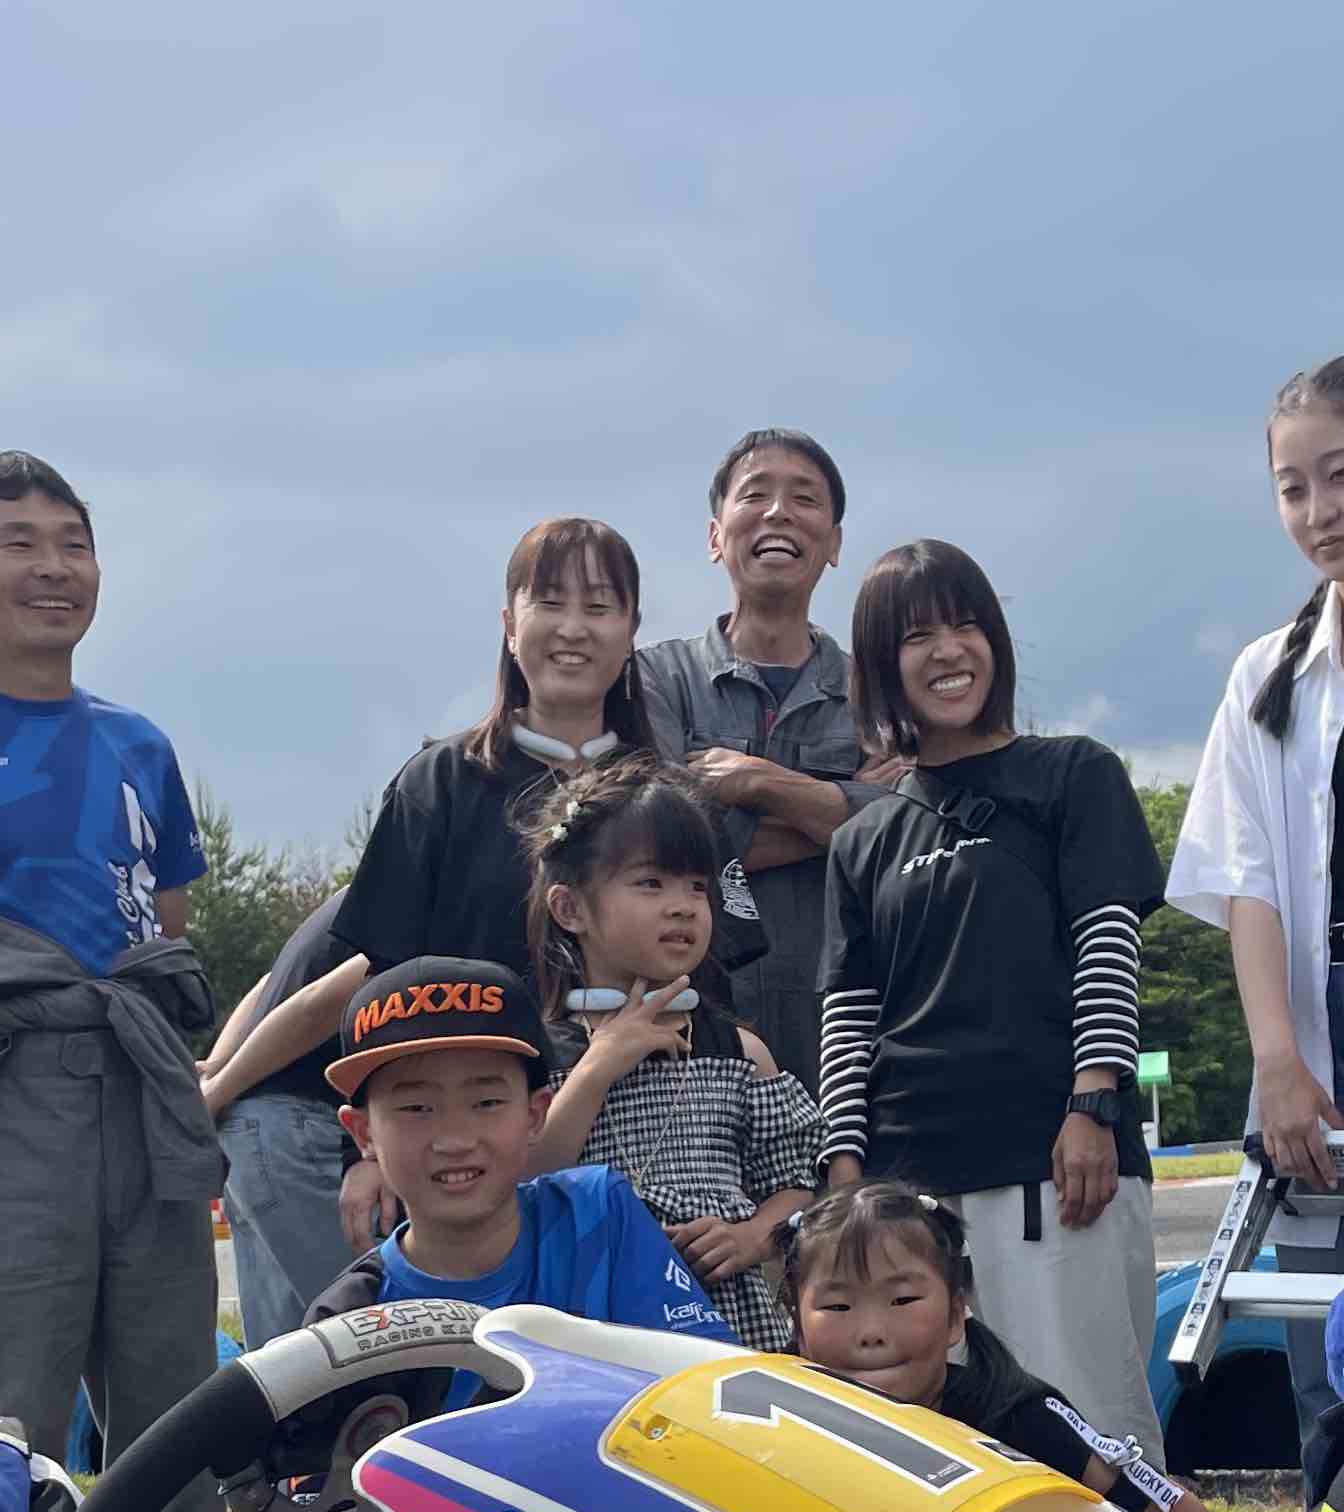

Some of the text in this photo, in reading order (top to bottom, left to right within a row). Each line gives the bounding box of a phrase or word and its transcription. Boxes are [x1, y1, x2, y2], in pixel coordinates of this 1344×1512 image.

[354, 982, 505, 1043] MAXXIS
[357, 1325, 435, 1351] RACING
[1128, 1461, 1166, 1494] LUCKY
